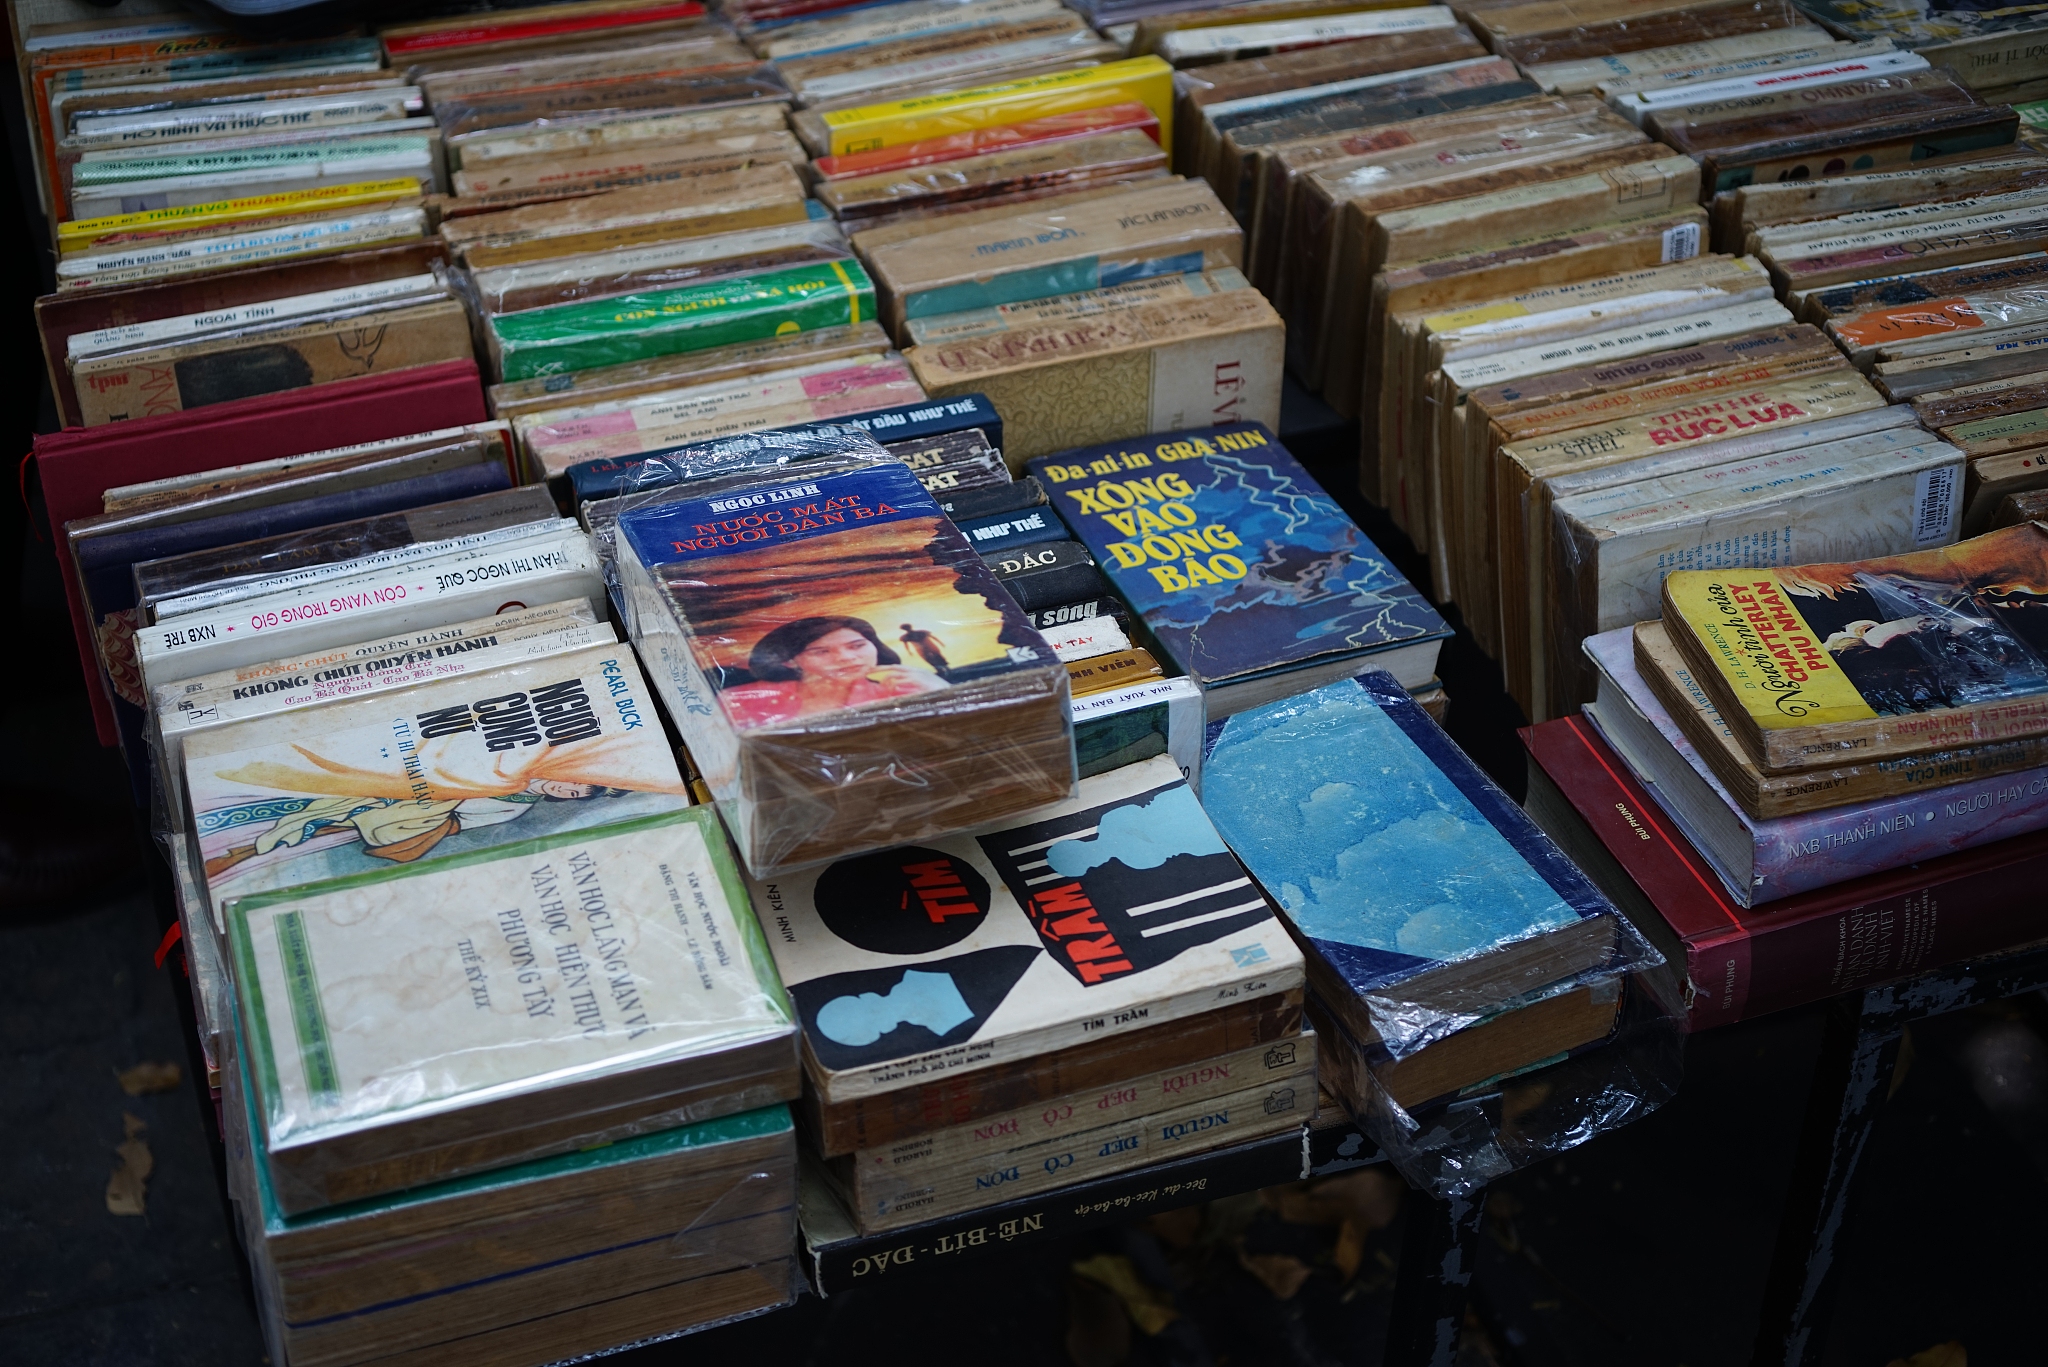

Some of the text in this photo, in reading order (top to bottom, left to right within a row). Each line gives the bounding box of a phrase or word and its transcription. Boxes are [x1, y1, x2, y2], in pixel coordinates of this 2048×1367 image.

[1156, 429, 1268, 464] GRA-NIN
[1563, 436, 1626, 459] STEEL
[707, 482, 821, 514] NGỌC LINH
[1066, 471, 1195, 516] XÔNG
[1101, 497, 1199, 538] VÀO
[1147, 552, 1248, 594] BÃO
[281, 600, 330, 623] TRONG
[330, 590, 373, 611] VANG
[373, 585, 407, 604] CÒN
[187, 624, 216, 644] NXB
[415, 627, 464, 645] HÀNH
[1722, 616, 1763, 658] tình
[1727, 583, 1809, 682] CHATTERLEY
[1752, 581, 1830, 671] PHU NHÂN
[1703, 622, 1742, 668] LAWRENCE
[599, 658, 643, 731] PEARL BUCK
[1674, 669, 1718, 715] LAWRENCE
[472, 691, 542, 752] CUNG
[398, 739, 425, 781] HI THÁI
[1802, 738, 1867, 755] LAWRENCE
[1786, 776, 1849, 798] LAWRENCE
[1634, 825, 1651, 841] BÙI
[1786, 785, 2029, 861] NXB THANH NIÊN NGƯỜI HAY
[530, 864, 561, 900] VĂN
[568, 850, 598, 889] VĂN
[539, 900, 572, 936] HỌC
[578, 888, 611, 923] HỌC
[766, 884, 797, 943] MINH KIÊN
[1850, 905, 1864, 951] DANH
[1863, 911, 1878, 956] DANH
[1920, 916, 1929, 945] PEOPLE
[497, 908, 542, 985] PHƯƠNG
[471, 985, 491, 1010] XIX
[1082, 1018, 1105, 1032] TÌM
[966, 1051, 992, 1065] MINH
[1161, 1062, 1231, 1095] NGƯỜI
[1096, 1085, 1138, 1111] ĐẸP
[1041, 1103, 1074, 1129] CÔ
[893, 1147, 934, 1164] HAROLD
[975, 1110, 1230, 1192] NGƯỜI ĐẸP CÔ ĐƠN
